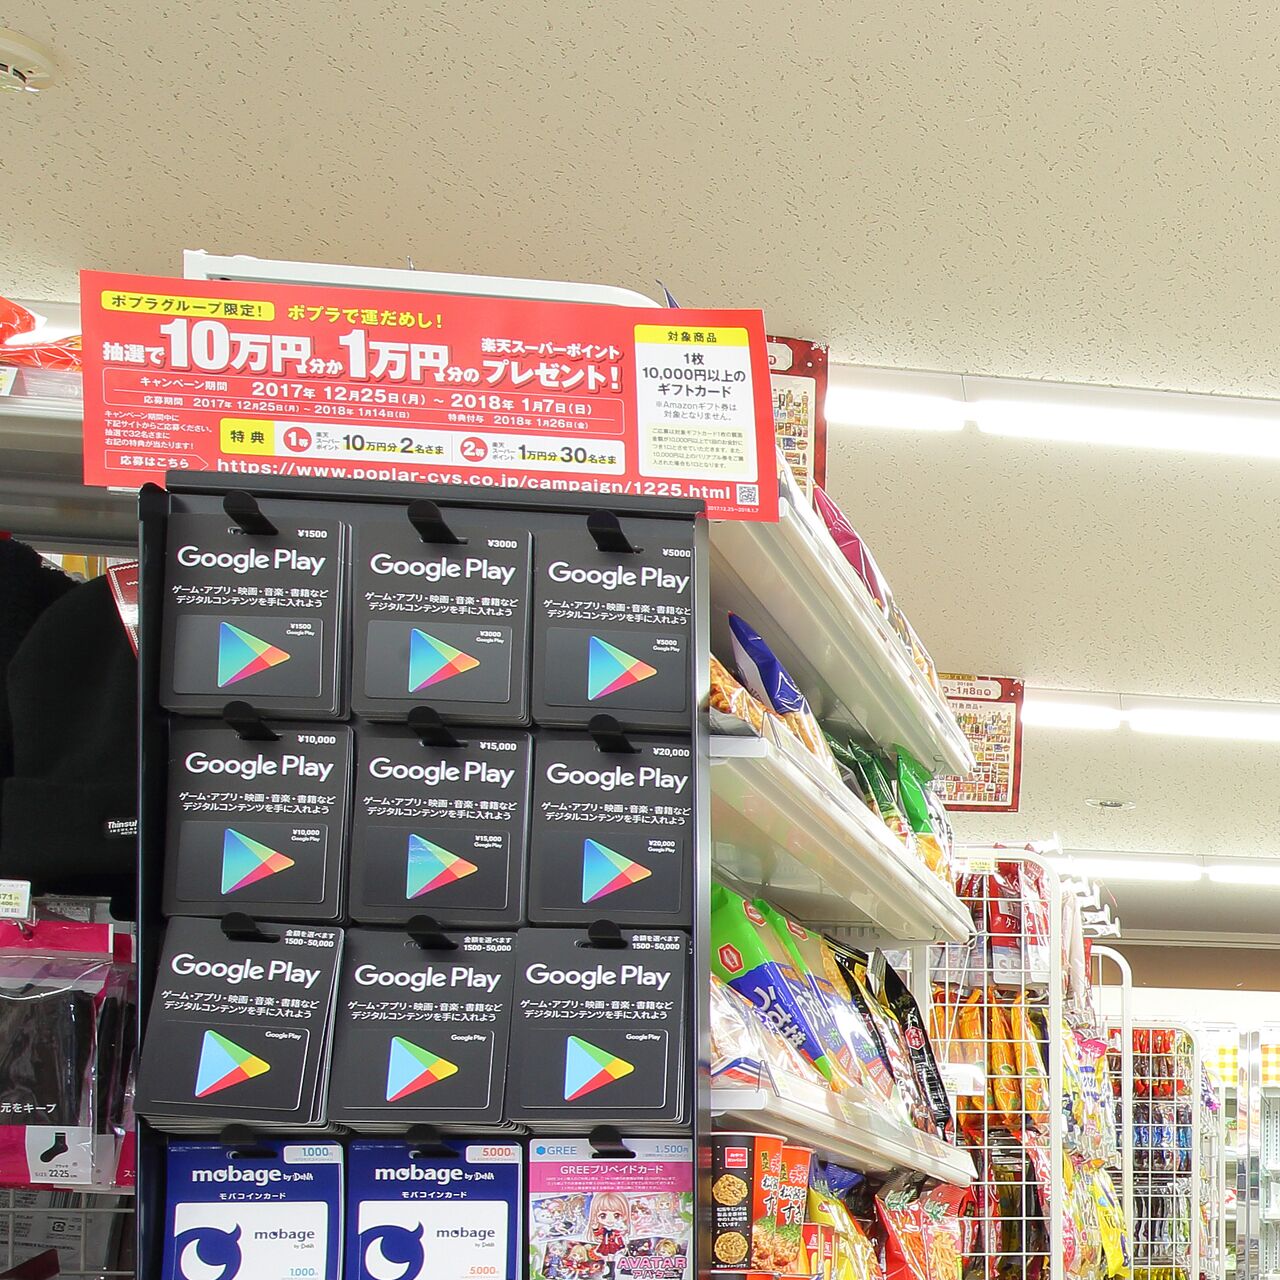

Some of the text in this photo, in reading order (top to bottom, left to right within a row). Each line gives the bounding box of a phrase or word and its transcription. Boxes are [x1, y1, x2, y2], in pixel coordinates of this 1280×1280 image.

[111, 294, 443, 329] ポプラグループ限定！ ポプラで運だめし！
[667, 331, 718, 343] 対象商品
[481, 337, 620, 360] 楽天スーパーポイント
[683, 352, 705, 366] 1枚
[642, 366, 746, 383] 10,000円以上の
[139, 376, 514, 411] キャンペーン期間 2017年 2018年
[657, 382, 732, 398] ギフトカード
[143, 394, 233, 410] 応募期間 2017年
[120, 455, 190, 469] 応募はこちら
[298, 529, 327, 539] ¥1500
[487, 539, 517, 549] ¥3000
[177, 545, 327, 577] Google Play
[370, 553, 517, 586] Google Play
[547, 561, 691, 594] Google Play
[176, 595, 323, 609] デジタルコンテンツを手に入れよう
[548, 609, 688, 626] デジタルコンテンツを手に入れよう
[297, 735, 336, 745] ¥10,000
[479, 742, 517, 752] ¥15,000
[653, 747, 691, 757] ¥20,000
[284, 938, 335, 948] 1500-50,000
[632, 942, 681, 951] 1500-50,000
[164, 1000, 313, 1019] デジタルコンテンツを手に入れよう
[547, 1146, 577, 1155] GREE
[191, 1165, 282, 1186] mobage
[375, 1164, 463, 1185] mobage
[560, 1164, 664, 1176] GREEプリペイドカード
[219, 1192, 287, 1200] モバコインカード
[401, 1190, 468, 1199] モバコインカード
[617, 1256, 687, 1269] AVATAR
